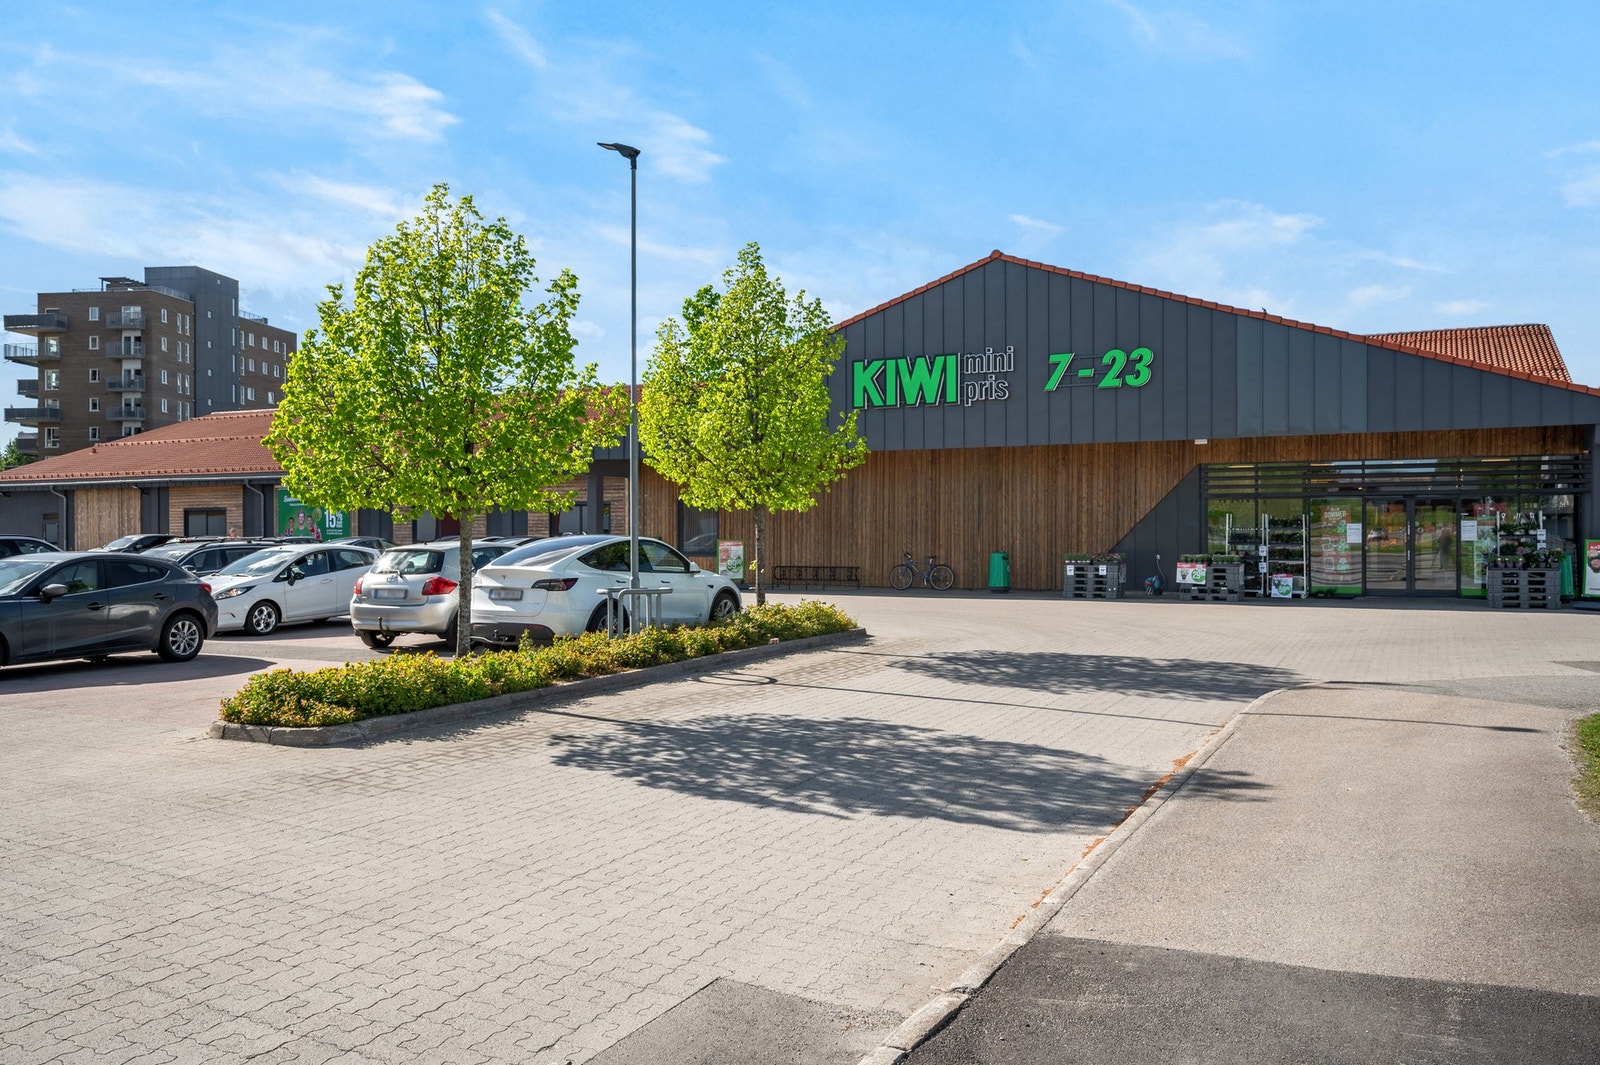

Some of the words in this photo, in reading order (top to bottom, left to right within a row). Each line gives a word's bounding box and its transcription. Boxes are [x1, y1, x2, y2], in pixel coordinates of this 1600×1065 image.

[963, 346, 1014, 374] mini
[852, 353, 960, 409] KIWI
[964, 375, 1009, 406] pris
